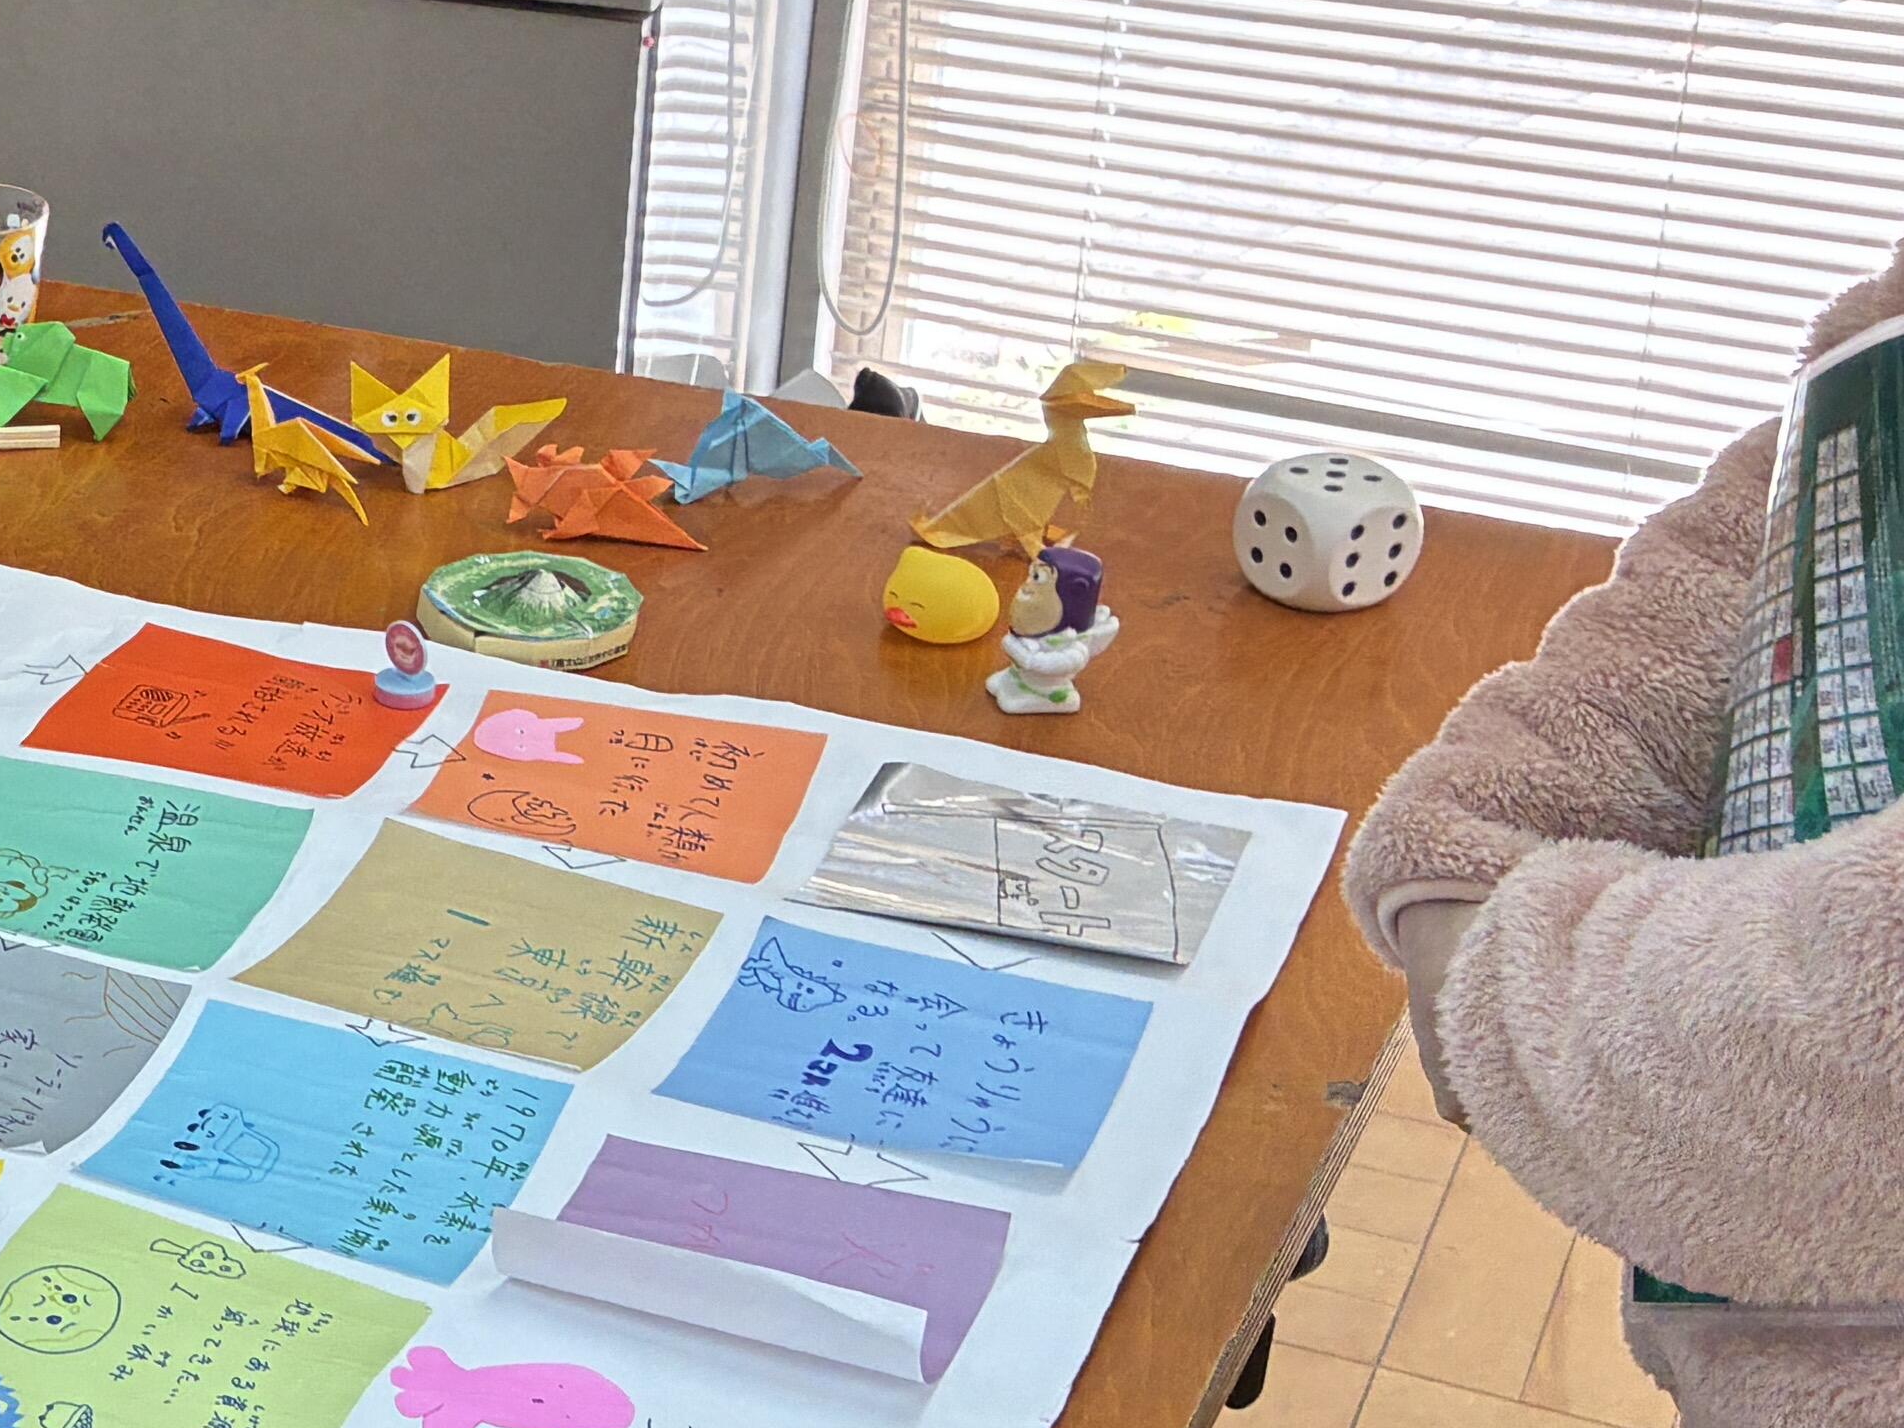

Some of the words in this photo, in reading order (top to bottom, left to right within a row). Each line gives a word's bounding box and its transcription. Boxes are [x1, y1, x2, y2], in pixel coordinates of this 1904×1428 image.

[582, 730, 678, 821] 月に行った
[1037, 825, 1106, 940] スタート
[467, 936, 576, 1011] 東京へ
[536, 912, 689, 1051] 新幹線で
[853, 990, 980, 1133] 会って友達に
[932, 1003, 1062, 1158] きょうりゅうに
